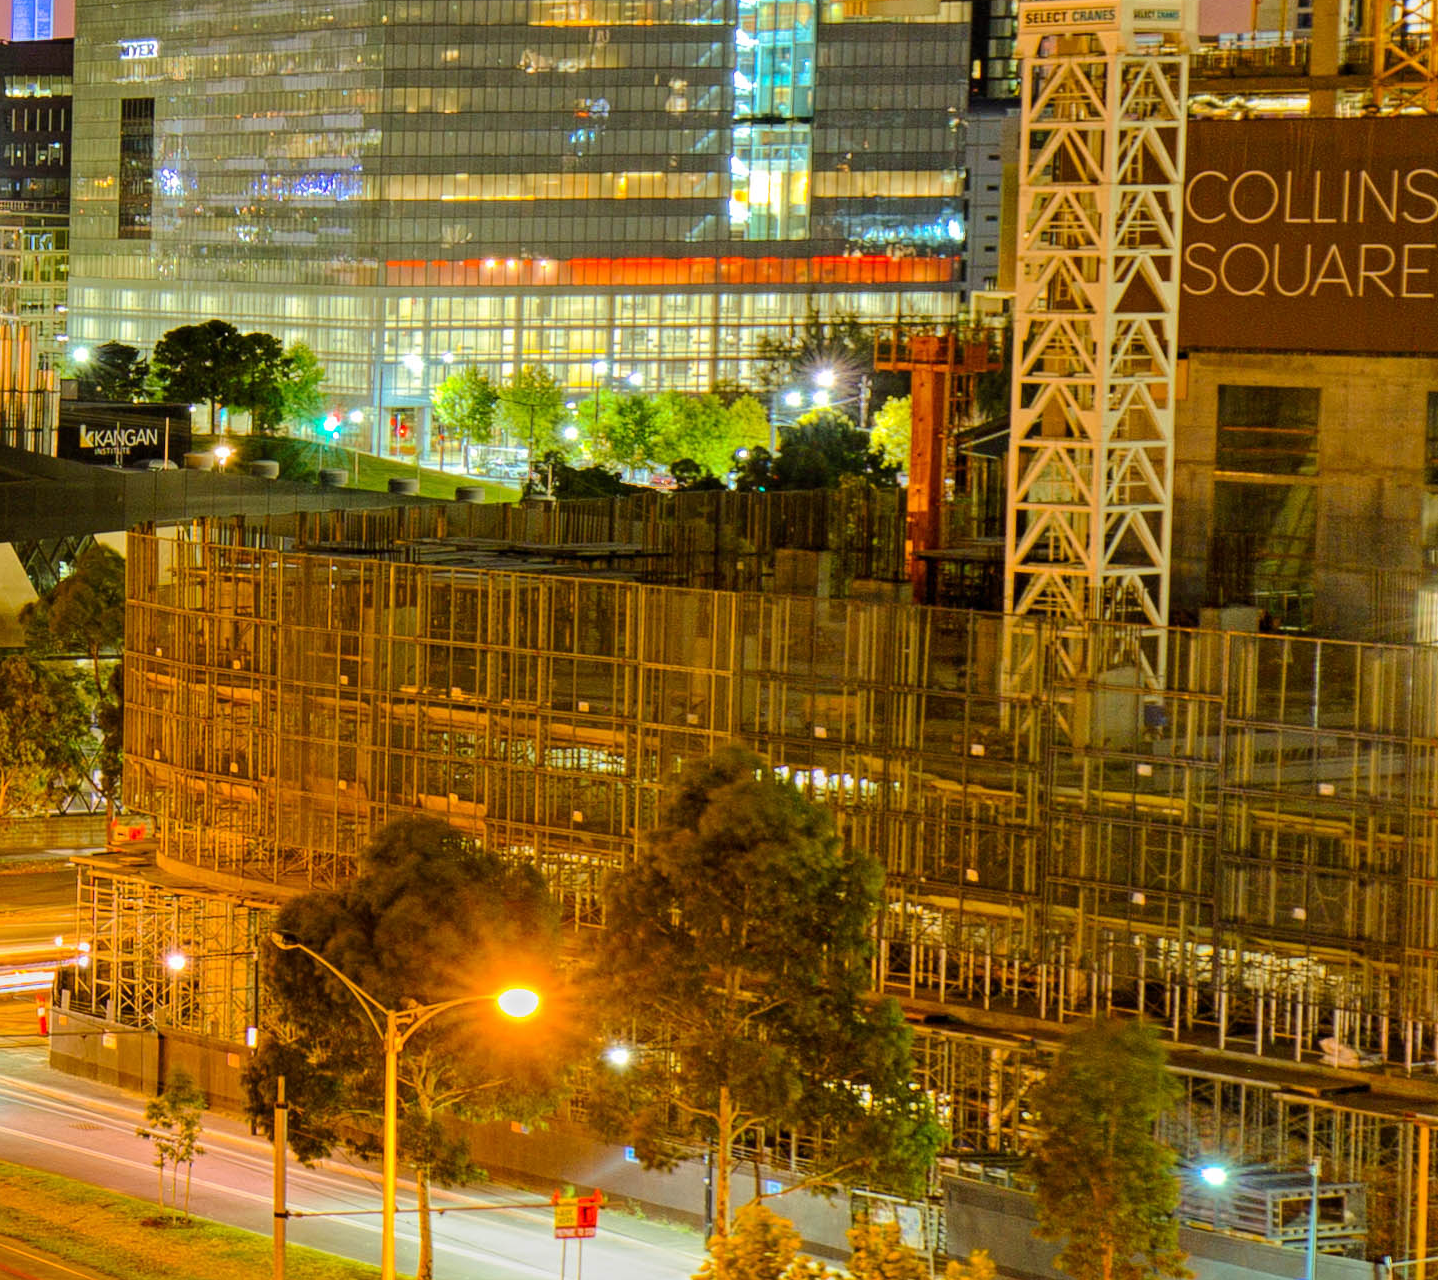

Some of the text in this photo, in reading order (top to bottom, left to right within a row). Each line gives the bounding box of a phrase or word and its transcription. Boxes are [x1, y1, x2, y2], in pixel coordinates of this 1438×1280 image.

[1025, 9, 1116, 24] SELECT CRANES
[1185, 169, 1438, 225] COLLINS
[1181, 242, 1437, 298] SQUARE
[94, 428, 158, 447] KANGAN
